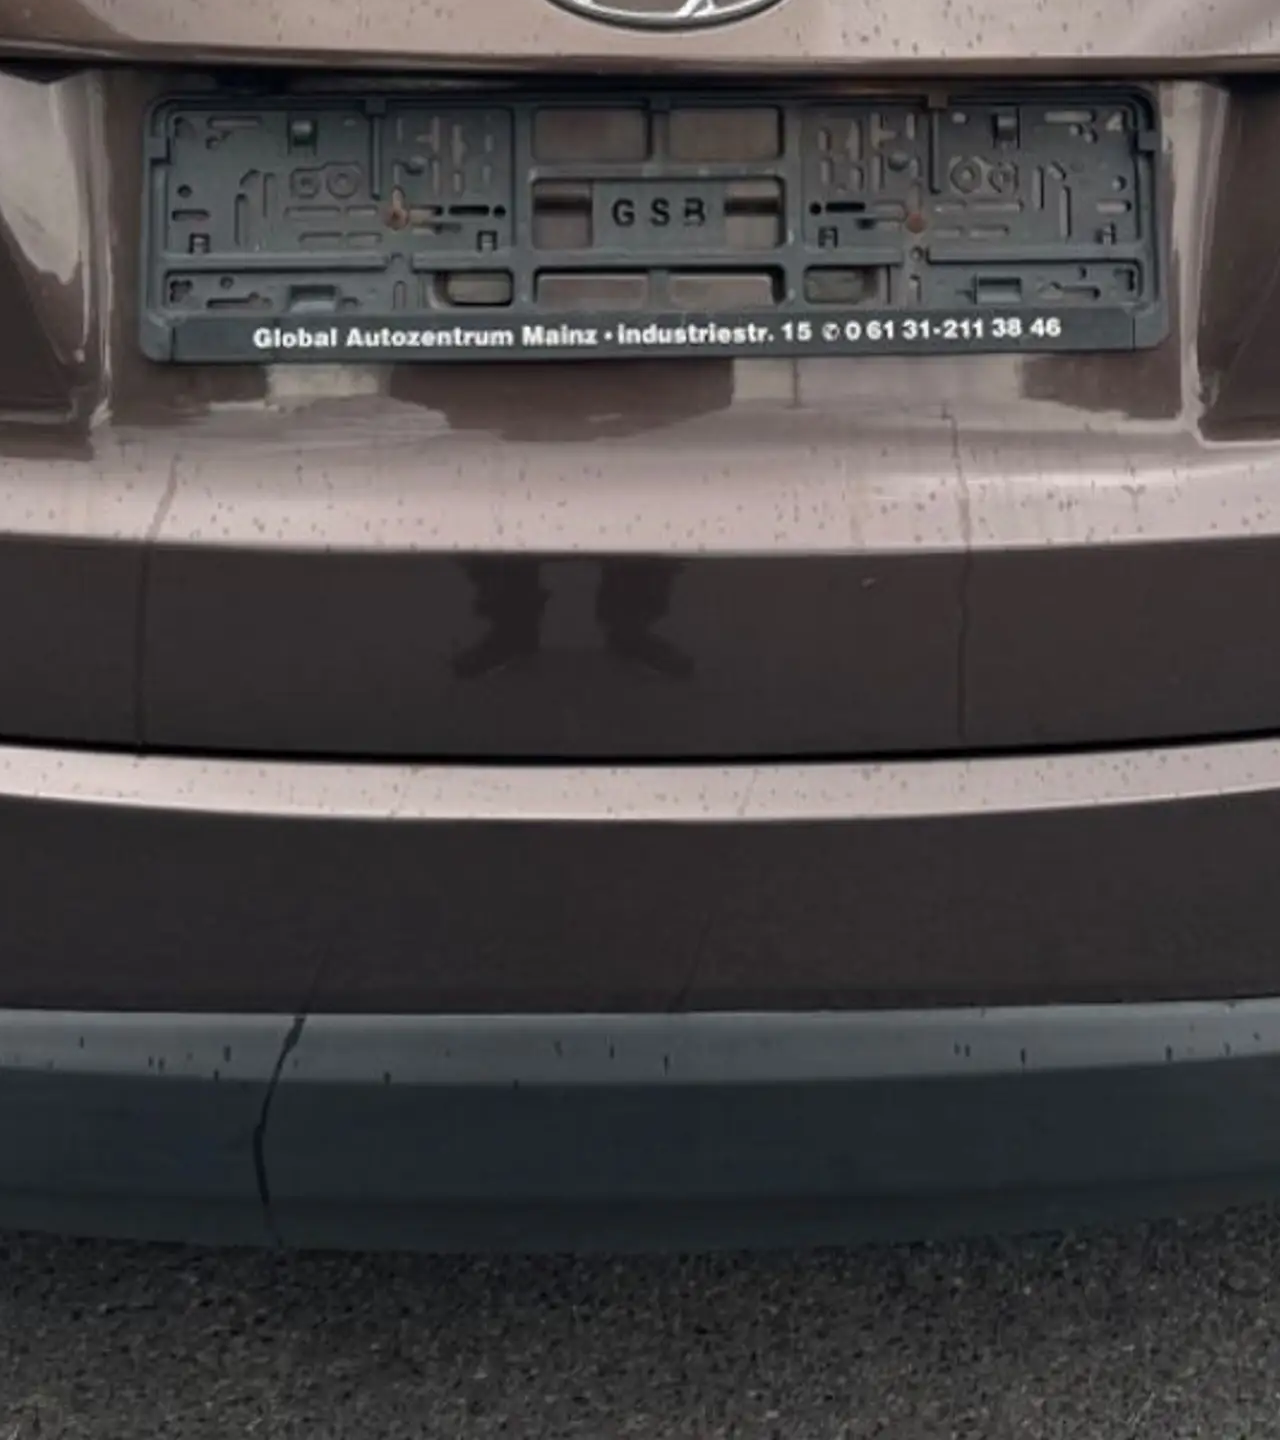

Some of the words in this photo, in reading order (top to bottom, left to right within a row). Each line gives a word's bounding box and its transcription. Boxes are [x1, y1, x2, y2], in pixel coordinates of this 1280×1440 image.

[253, 327, 337, 348] Global
[346, 327, 514, 348] Autozentrum
[521, 324, 598, 347] Mainz
[781, 321, 812, 341] 15
[991, 317, 1023, 338] 38
[1030, 317, 1062, 338] 46
